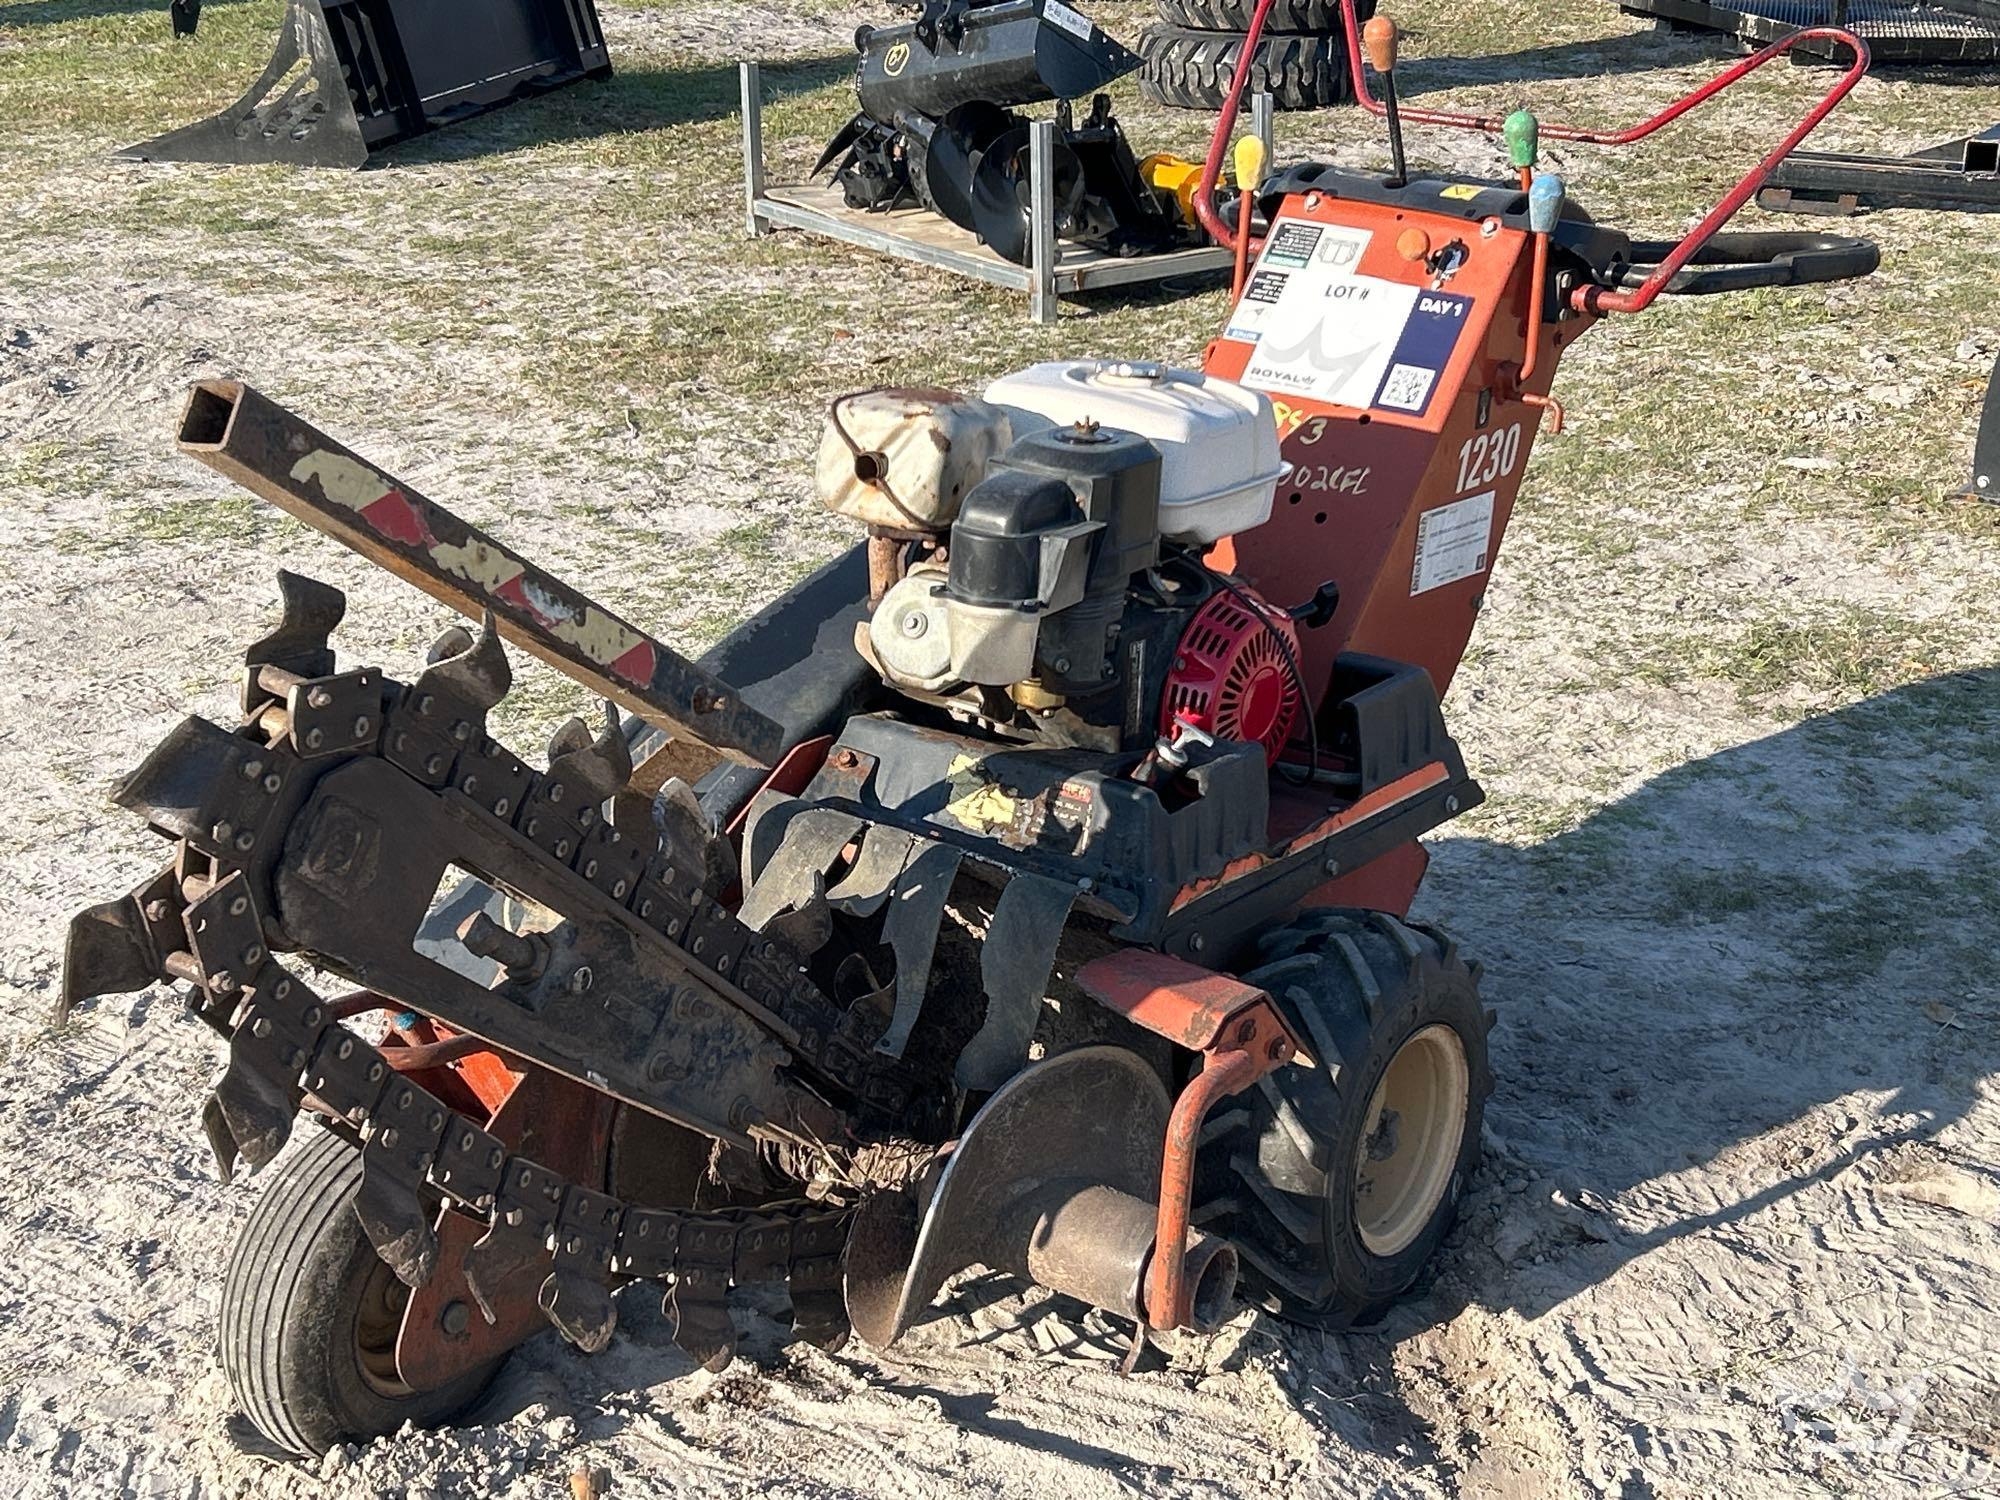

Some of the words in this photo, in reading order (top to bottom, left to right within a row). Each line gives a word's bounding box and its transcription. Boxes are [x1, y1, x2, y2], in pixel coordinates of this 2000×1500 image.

[1325, 285, 1358, 300] LOT
[1419, 297, 1454, 315] DAY
[1454, 302, 1464, 317] 1
[1251, 367, 1301, 383] ROYAL
[1455, 422, 1521, 494] 1230
